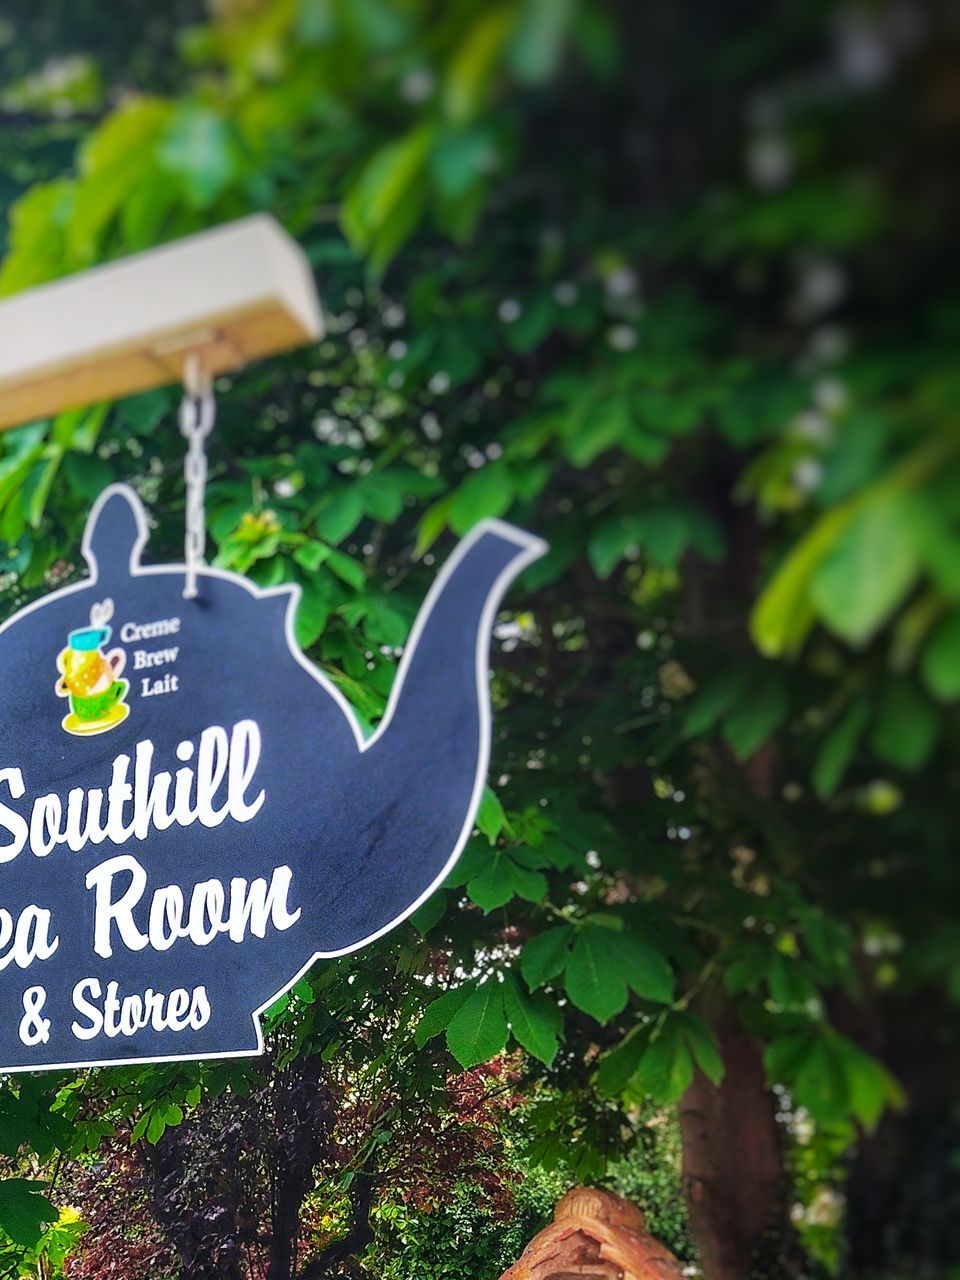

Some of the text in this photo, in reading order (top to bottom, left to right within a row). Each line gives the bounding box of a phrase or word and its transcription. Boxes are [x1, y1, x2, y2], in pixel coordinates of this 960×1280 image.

[120, 617, 181, 643] Creme
[133, 646, 180, 670] Brew
[140, 673, 180, 697] Lait
[85, 855, 301, 958] Room
[19, 978, 212, 1046] & Stores
